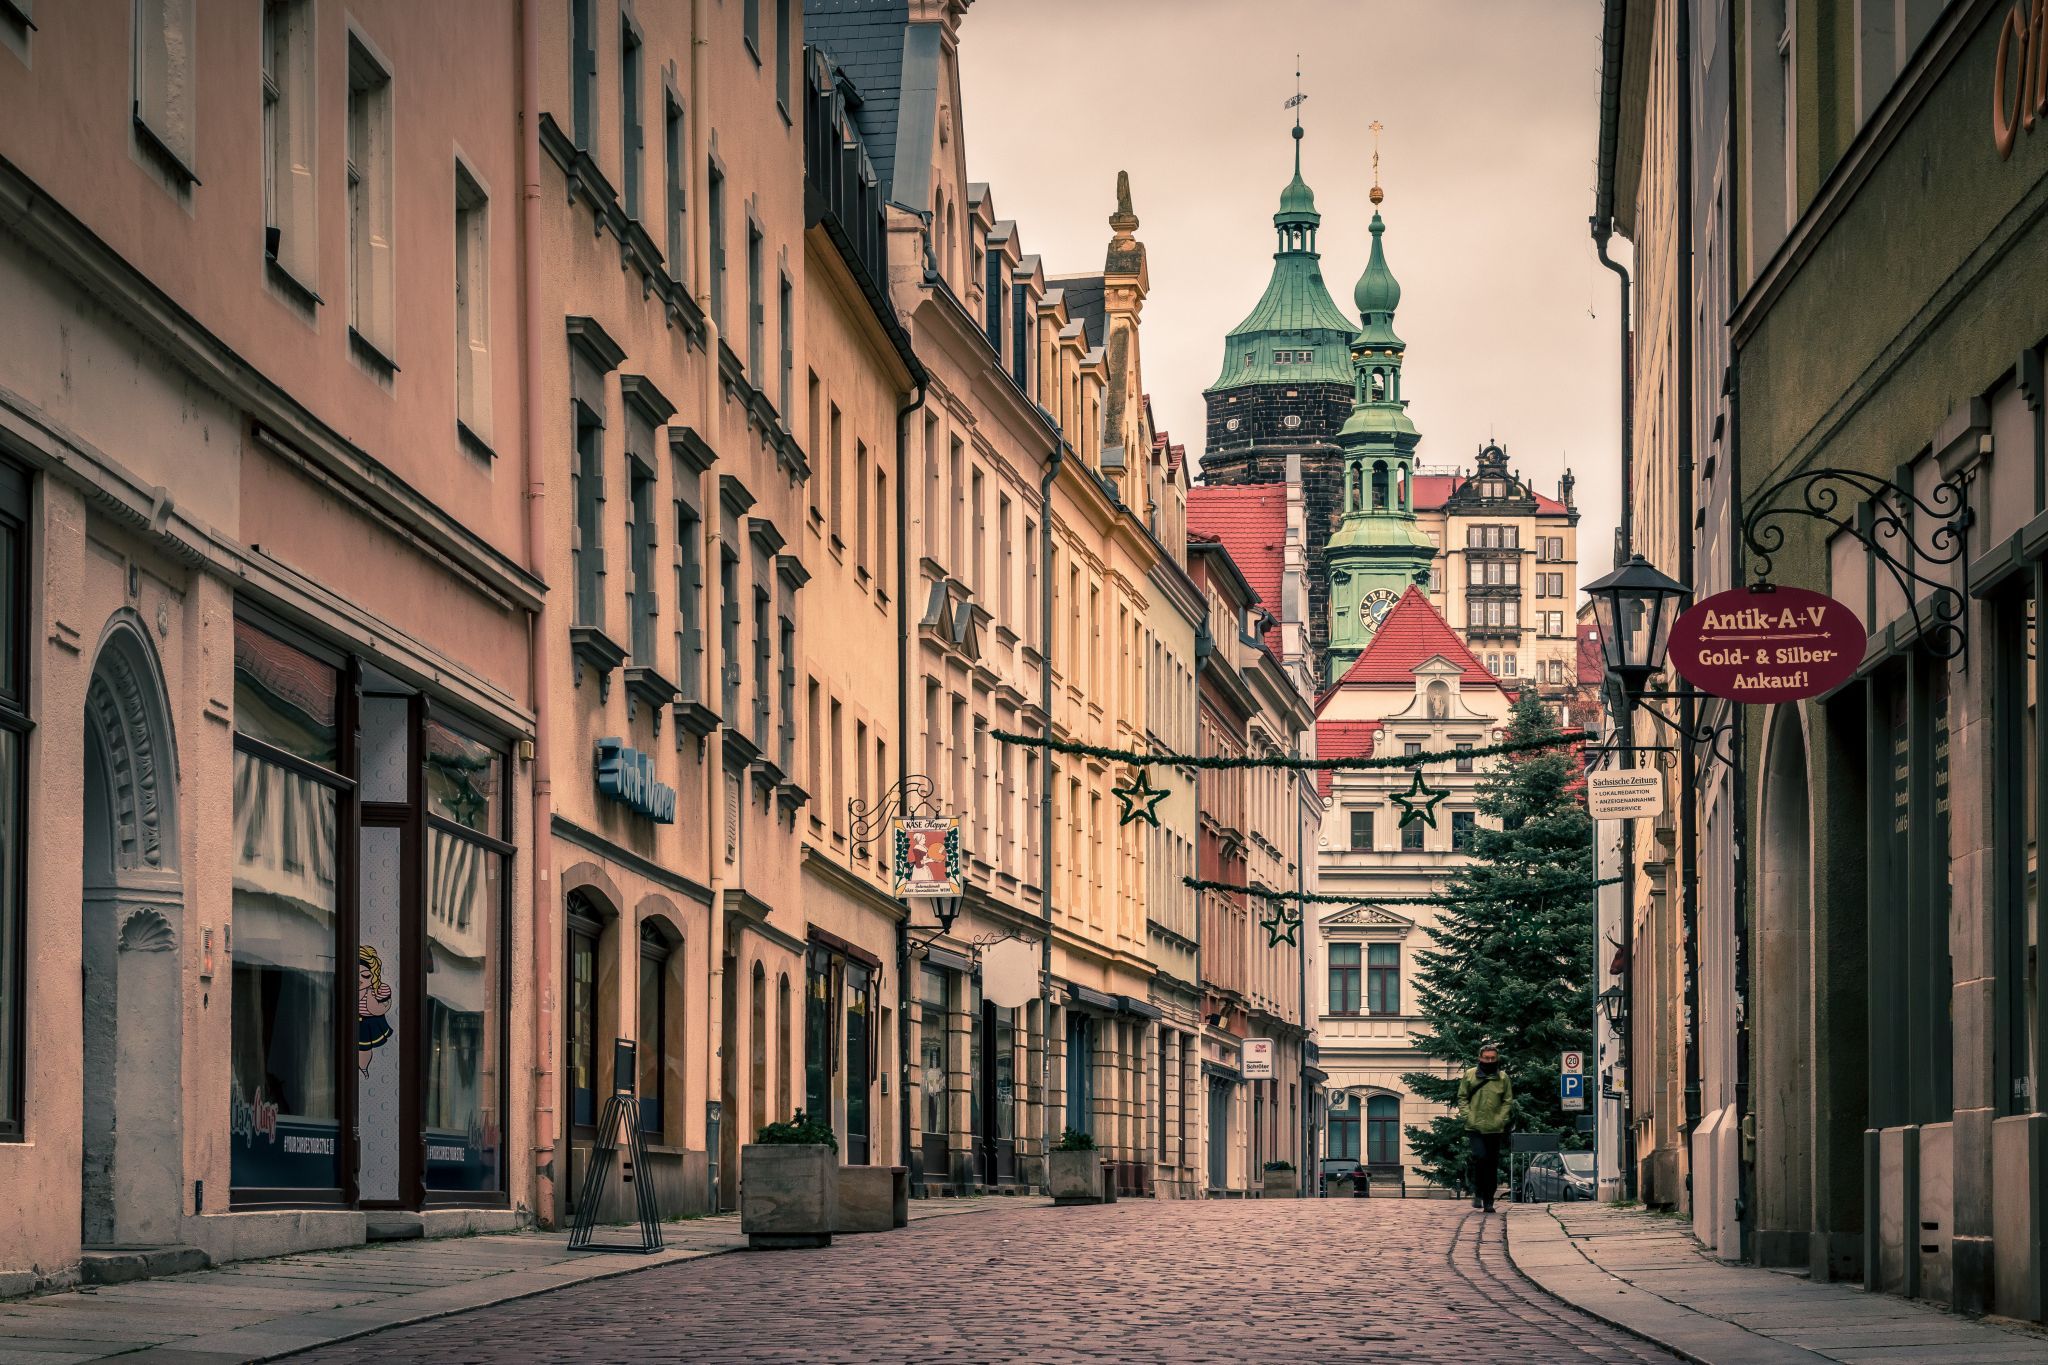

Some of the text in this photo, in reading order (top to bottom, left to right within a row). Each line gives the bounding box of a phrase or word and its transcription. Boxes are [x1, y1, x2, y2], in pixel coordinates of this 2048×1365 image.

[1702, 606, 1826, 630] Antik-A+V
[1698, 647, 1838, 665] Gold- & Silber-
[1733, 672, 1809, 689] Ankauf!
[1592, 776, 1657, 786] Sächsische Zeitung
[1566, 1077, 1578, 1095] P
